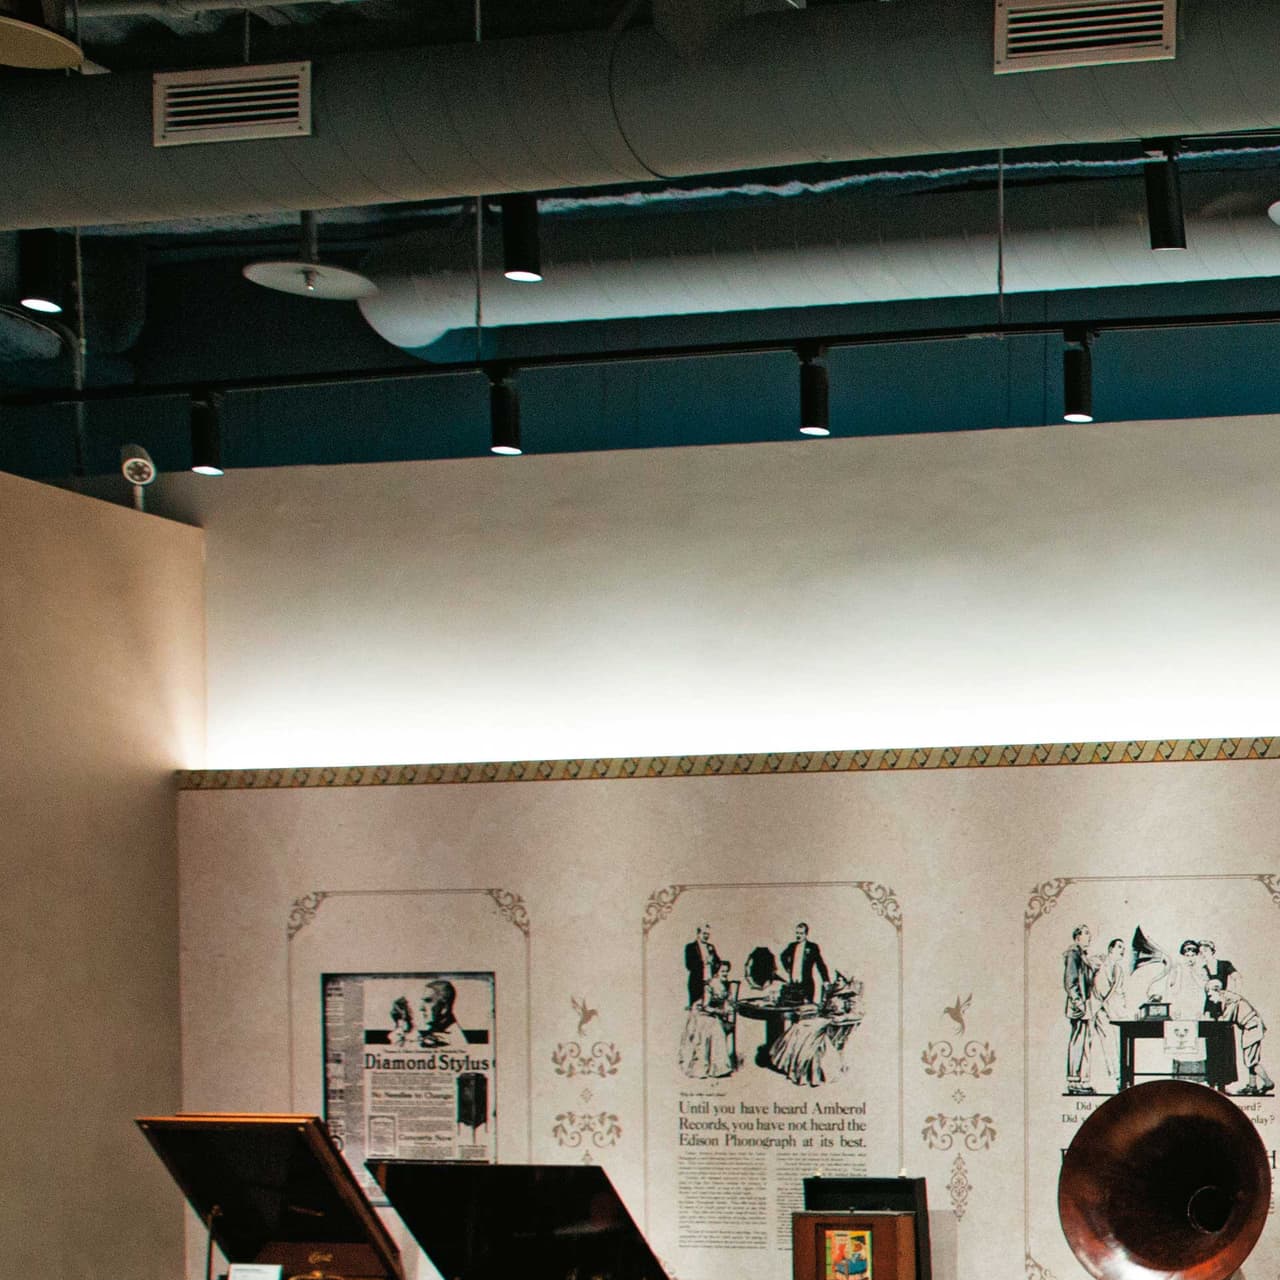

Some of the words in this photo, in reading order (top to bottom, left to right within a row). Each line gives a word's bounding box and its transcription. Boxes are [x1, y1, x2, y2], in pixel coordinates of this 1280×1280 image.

[365, 1053, 436, 1070] Diamond
[438, 1054, 489, 1072] Stylus
[679, 1101, 709, 1115] Until
[714, 1104, 735, 1118] you
[741, 1101, 769, 1115] have
[773, 1101, 807, 1115] heard
[812, 1101, 866, 1115] Amberol
[1076, 1102, 1092, 1110] Did
[679, 1117, 730, 1132] Records,
[732, 1120, 755, 1135] you
[756, 1117, 785, 1131] have
[788, 1119, 807, 1131] not
[810, 1117, 844, 1131] heard
[847, 1117, 866, 1132] the
[1062, 1114, 1078, 1123] Did
[679, 1133, 719, 1146] Edison
[725, 1133, 796, 1149] Phonograph
[802, 1136, 813, 1147] at
[820, 1134, 834, 1147] its
[840, 1134, 866, 1148] best.
